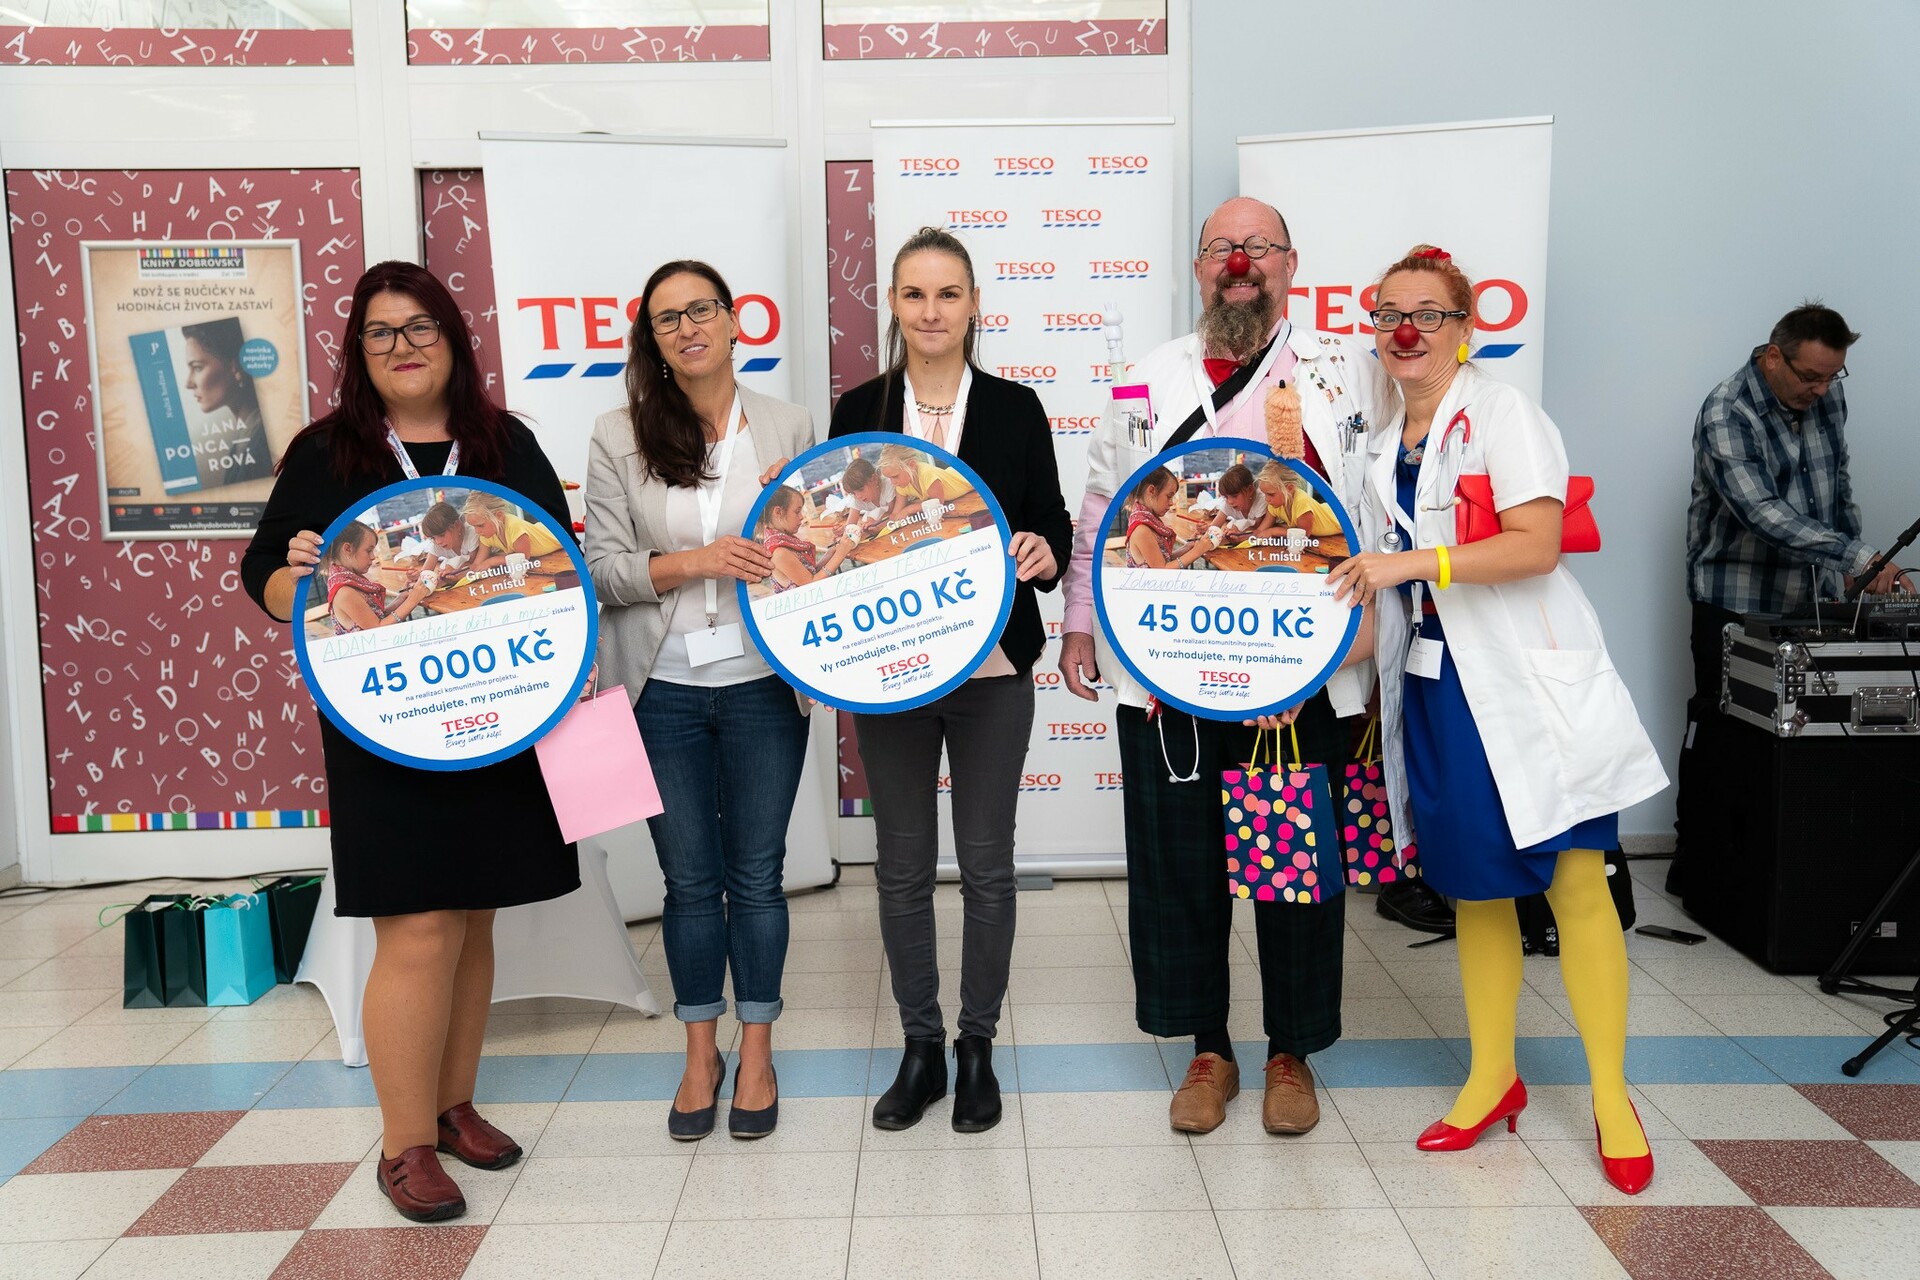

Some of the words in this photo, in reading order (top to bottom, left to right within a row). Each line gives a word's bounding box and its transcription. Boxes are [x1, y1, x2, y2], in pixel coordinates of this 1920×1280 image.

[900, 158, 960, 171] TESCO
[994, 157, 1054, 170] TESCO
[1088, 156, 1148, 169] TESCO
[948, 210, 1008, 223] TESCO
[1042, 209, 1102, 222] TESCO
[142, 259, 176, 268] KNIHY
[996, 262, 1056, 275] TESCO
[1089, 260, 1149, 274] TESCO
[133, 284, 163, 296] KDYŽ
[167, 288, 180, 296] SE
[184, 284, 236, 296] RUČIČKY
[240, 286, 255, 296] NA
[117, 300, 180, 312] HODINÁCH
[184, 300, 224, 311] ŽIVOTA
[228, 298, 273, 310] ZASTAVÍ
[517, 294, 781, 350] TEO
[1043, 314, 1102, 326] TESCO
[996, 366, 1057, 378] TESCO
[201, 418, 248, 436] JANA
[208, 449, 256, 472] ROVÁ
[886, 502, 956, 531] Gratulujeme
[890, 534, 898, 545] k
[900, 532, 909, 543] 1.
[912, 522, 943, 540] místu
[1248, 536, 1320, 549] Gratulujeme
[1248, 552, 1255, 561] k
[1256, 551, 1266, 561] 1.
[1269, 550, 1302, 562] místu
[465, 558, 542, 583] Gratulujeme
[469, 586, 477, 598] k
[478, 583, 489, 595] 1.
[492, 576, 526, 594] místu
[802, 613, 843, 648] 45
[852, 589, 923, 633] 000
[930, 568, 976, 610] Kč
[1138, 604, 1178, 632] 45
[1190, 606, 1259, 636] 000
[1273, 607, 1314, 638] Kč
[851, 636, 876, 648] realizaci
[877, 623, 916, 639] komunitního
[916, 615, 944, 629] projektu.
[322, 633, 376, 662] ADAM
[820, 663, 833, 673] Vy
[835, 644, 900, 669] rozhodujete,
[902, 637, 916, 648] my
[918, 618, 975, 644] pomáháme
[1208, 639, 1246, 647] komunitního
[360, 661, 408, 697] 45
[420, 643, 496, 685] 000
[507, 628, 556, 668] Kč
[1148, 648, 1160, 659] Vy
[1162, 650, 1226, 662] rozhodujete,
[1228, 654, 1243, 663] my
[1246, 654, 1303, 664] pomáháme
[877, 653, 930, 677] TESCO
[1199, 670, 1250, 684] TESCO
[415, 688, 444, 700] realizaci
[444, 679, 488, 693] komunitního
[488, 674, 519, 686] projektu.
[379, 711, 394, 724] Vy
[396, 698, 468, 720] rozhodujete,
[470, 694, 487, 704] my
[489, 680, 550, 702] pomáháme
[441, 712, 499, 732] TESCO
[1048, 723, 1107, 735] TESCO
